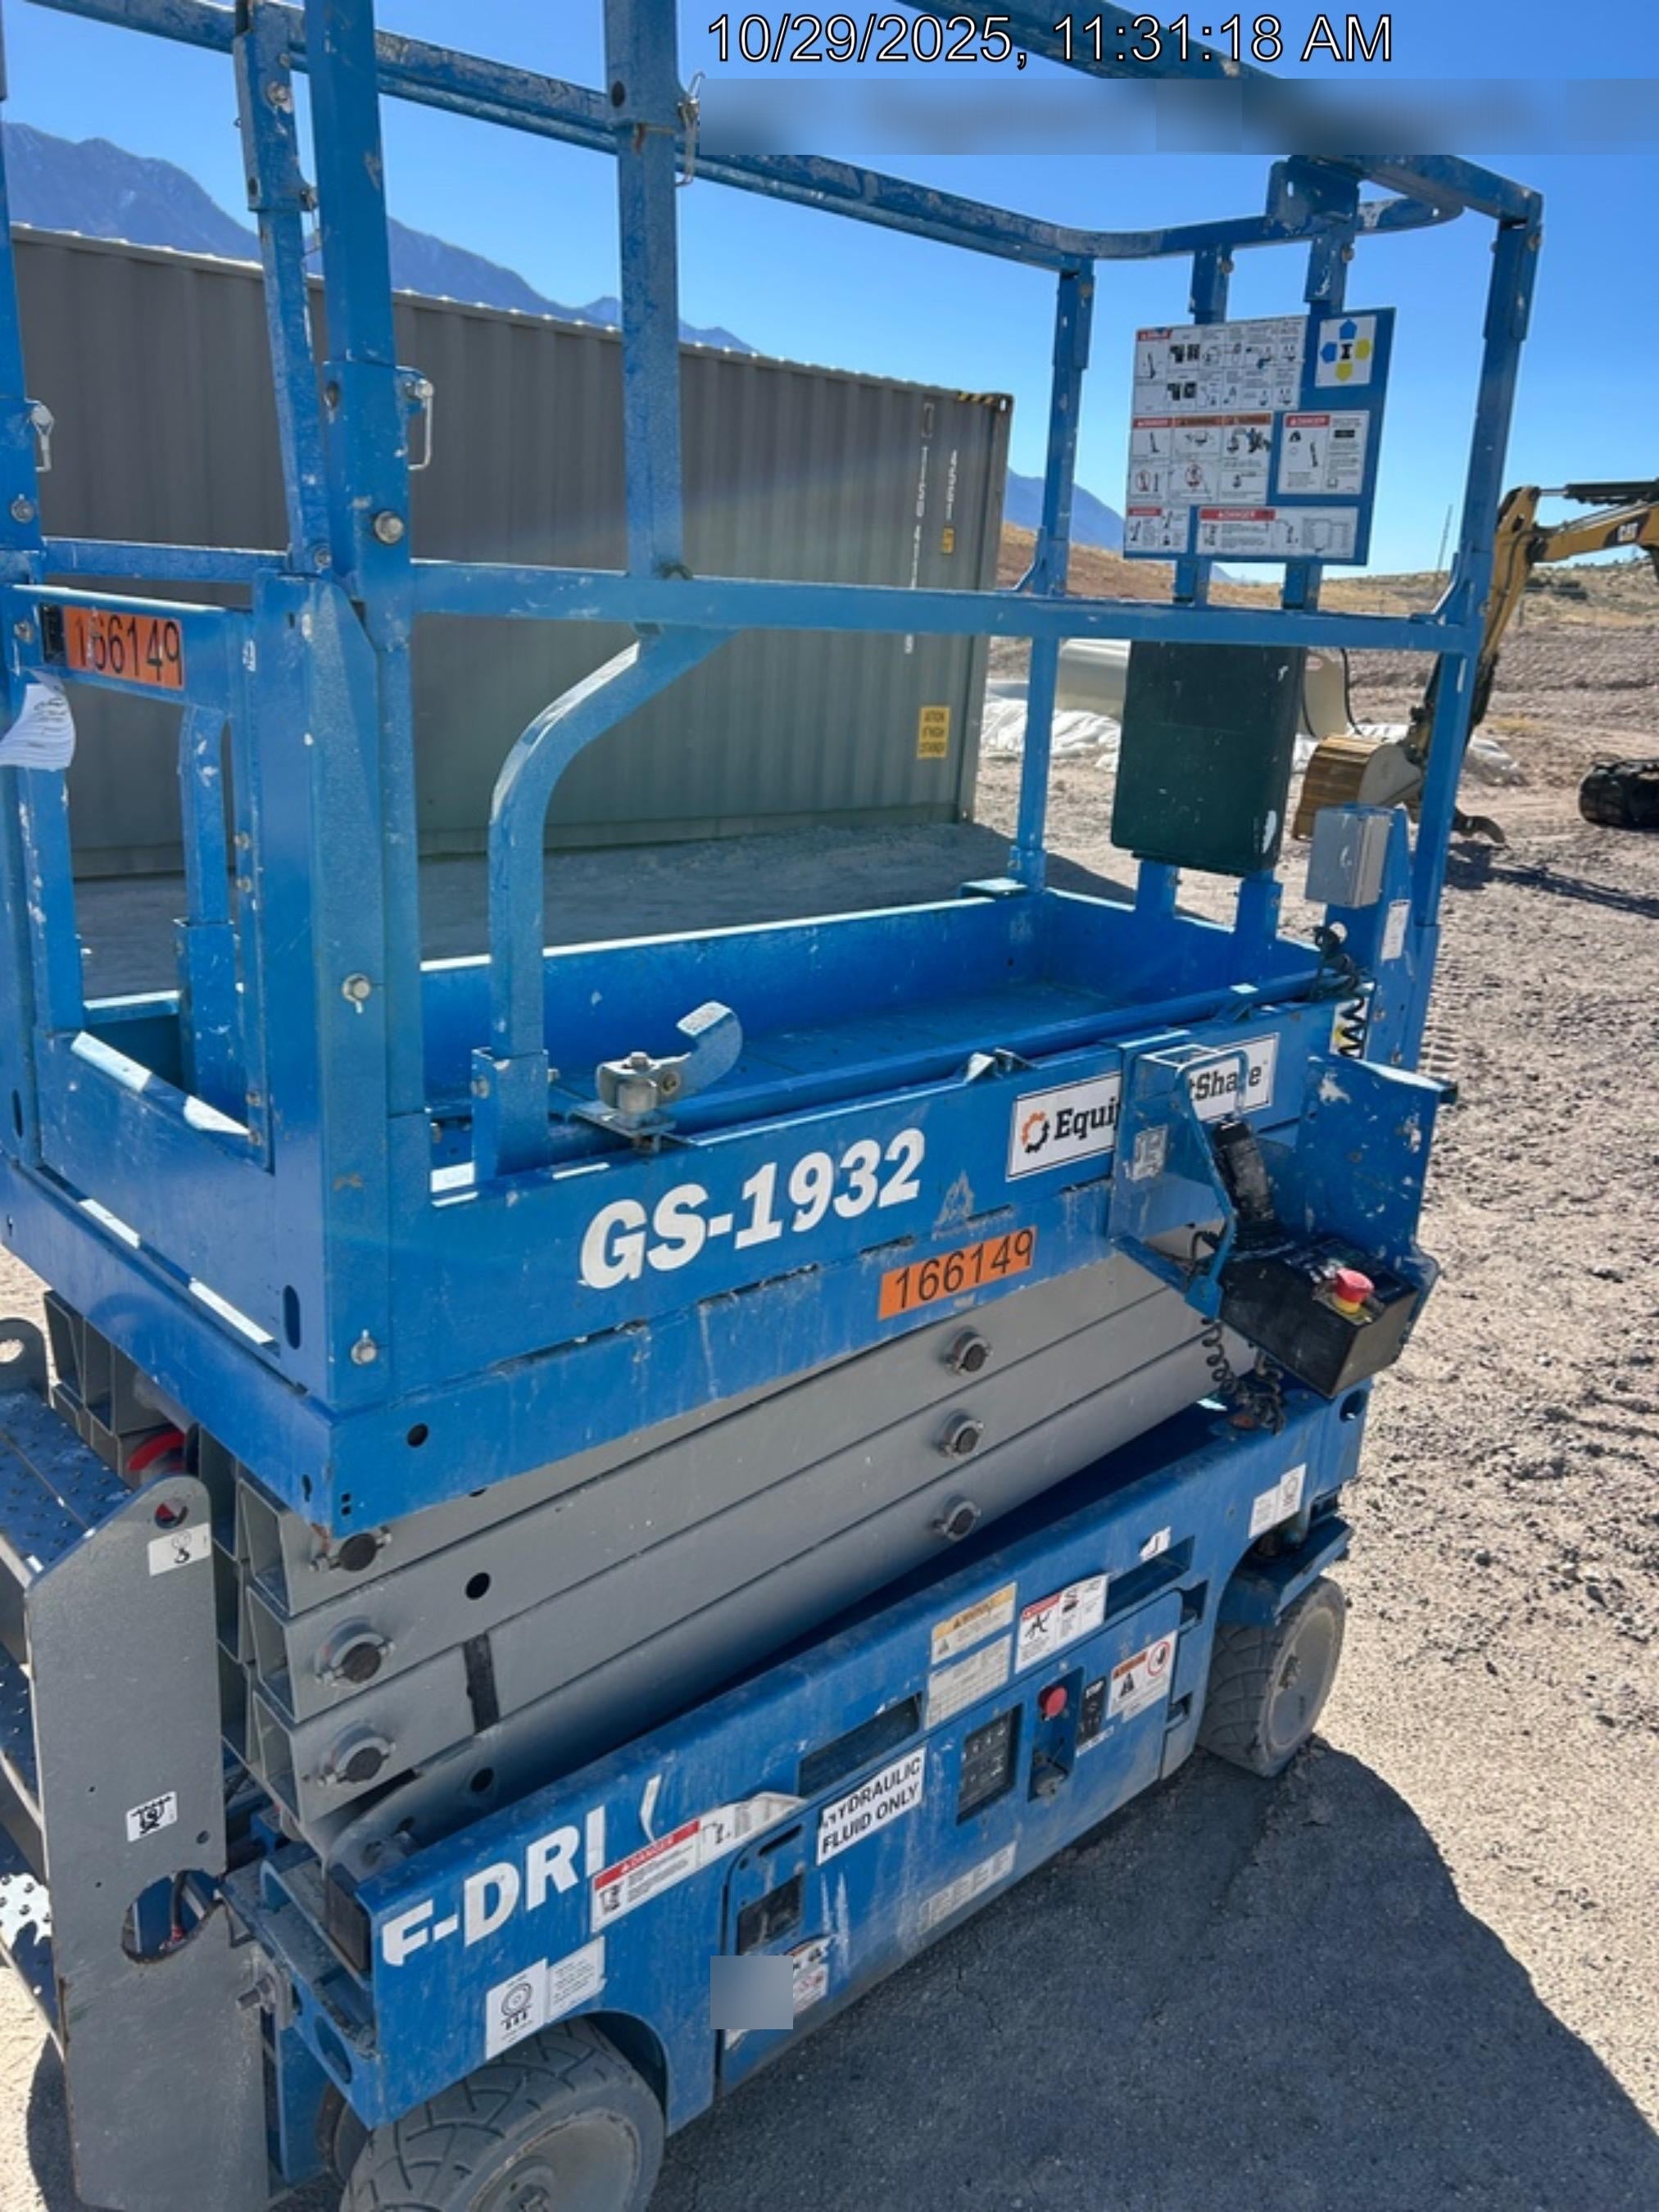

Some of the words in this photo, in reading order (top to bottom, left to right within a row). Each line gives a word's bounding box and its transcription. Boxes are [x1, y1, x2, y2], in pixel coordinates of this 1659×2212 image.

[76, 614, 182, 685] 166149
[578, 1127, 926, 1289] GS-1932
[895, 1229, 1034, 1308] 166149
[823, 1812, 871, 1854] FLUID
[877, 1781, 918, 1820] ONLY
